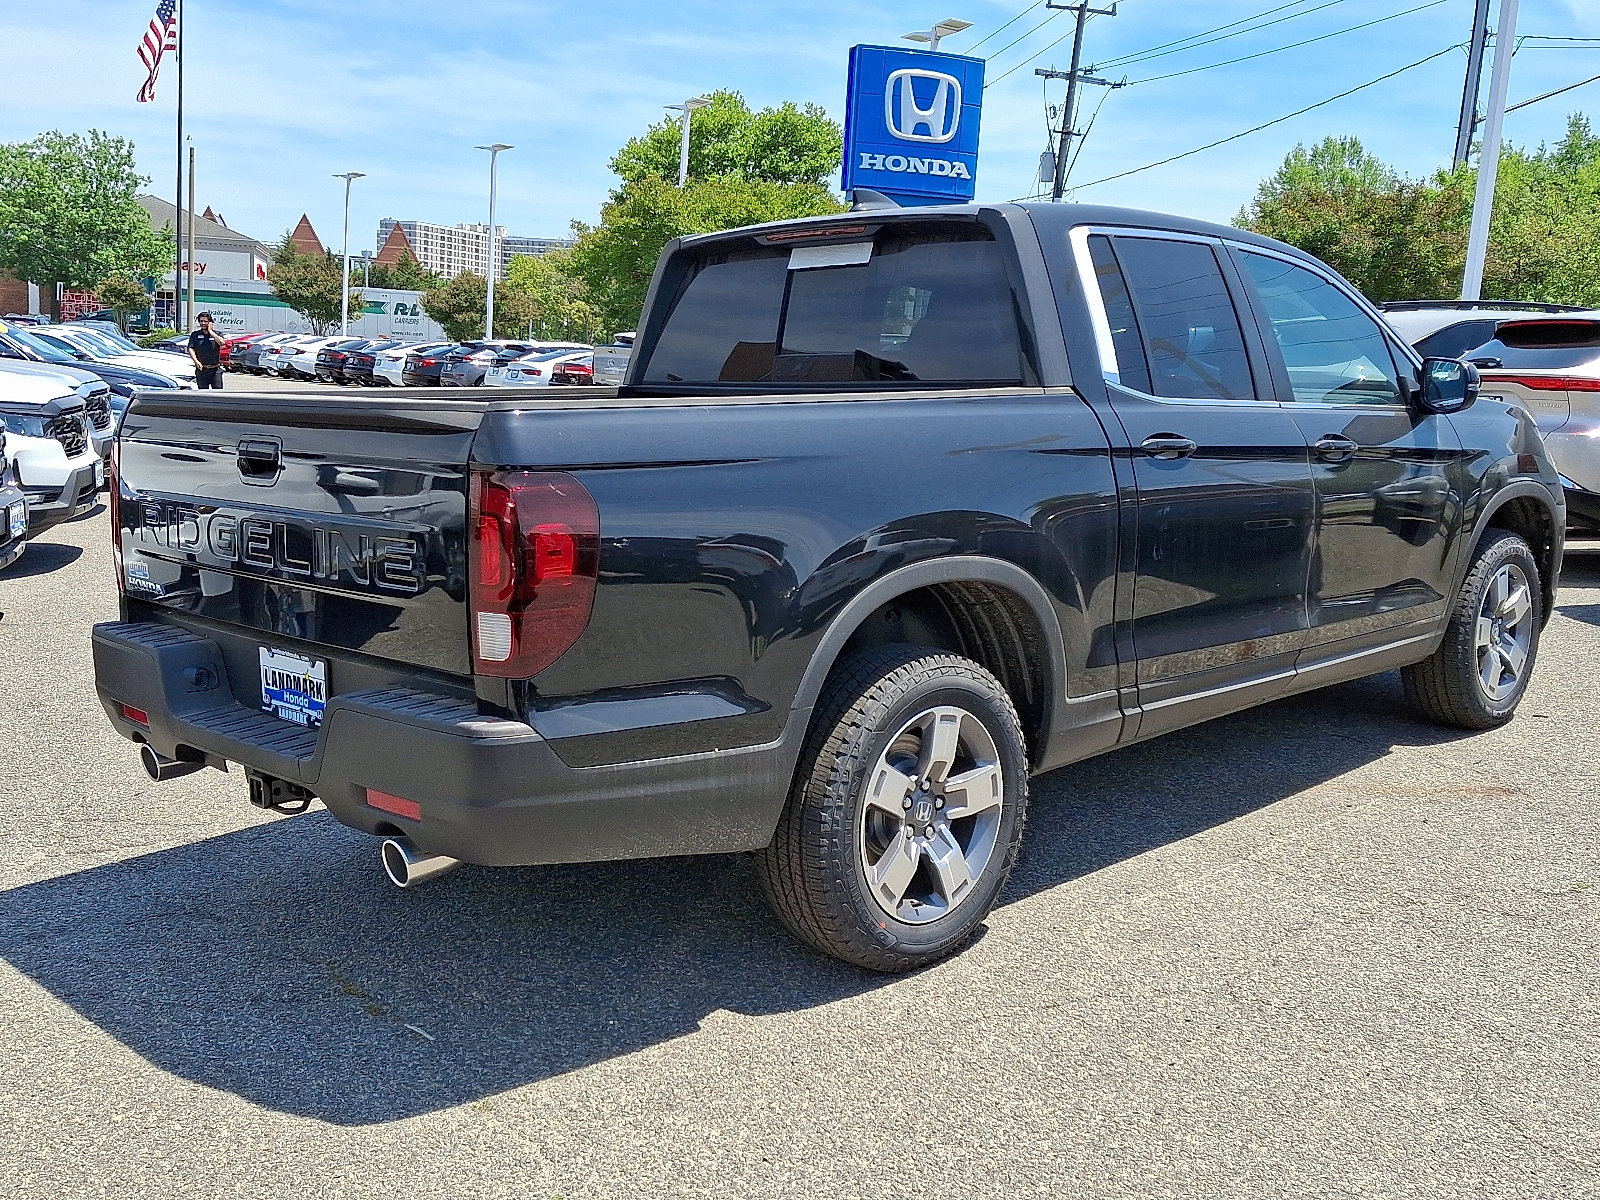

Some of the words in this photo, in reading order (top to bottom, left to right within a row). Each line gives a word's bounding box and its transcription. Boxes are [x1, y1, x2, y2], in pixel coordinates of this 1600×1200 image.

[859, 152, 972, 180] HONDA
[219, 316, 245, 326] Service
[394, 317, 421, 326] CARRIERS
[138, 500, 420, 593] RIDGELINE
[264, 668, 325, 702] LANDMARK
[283, 690, 310, 708] Honda
